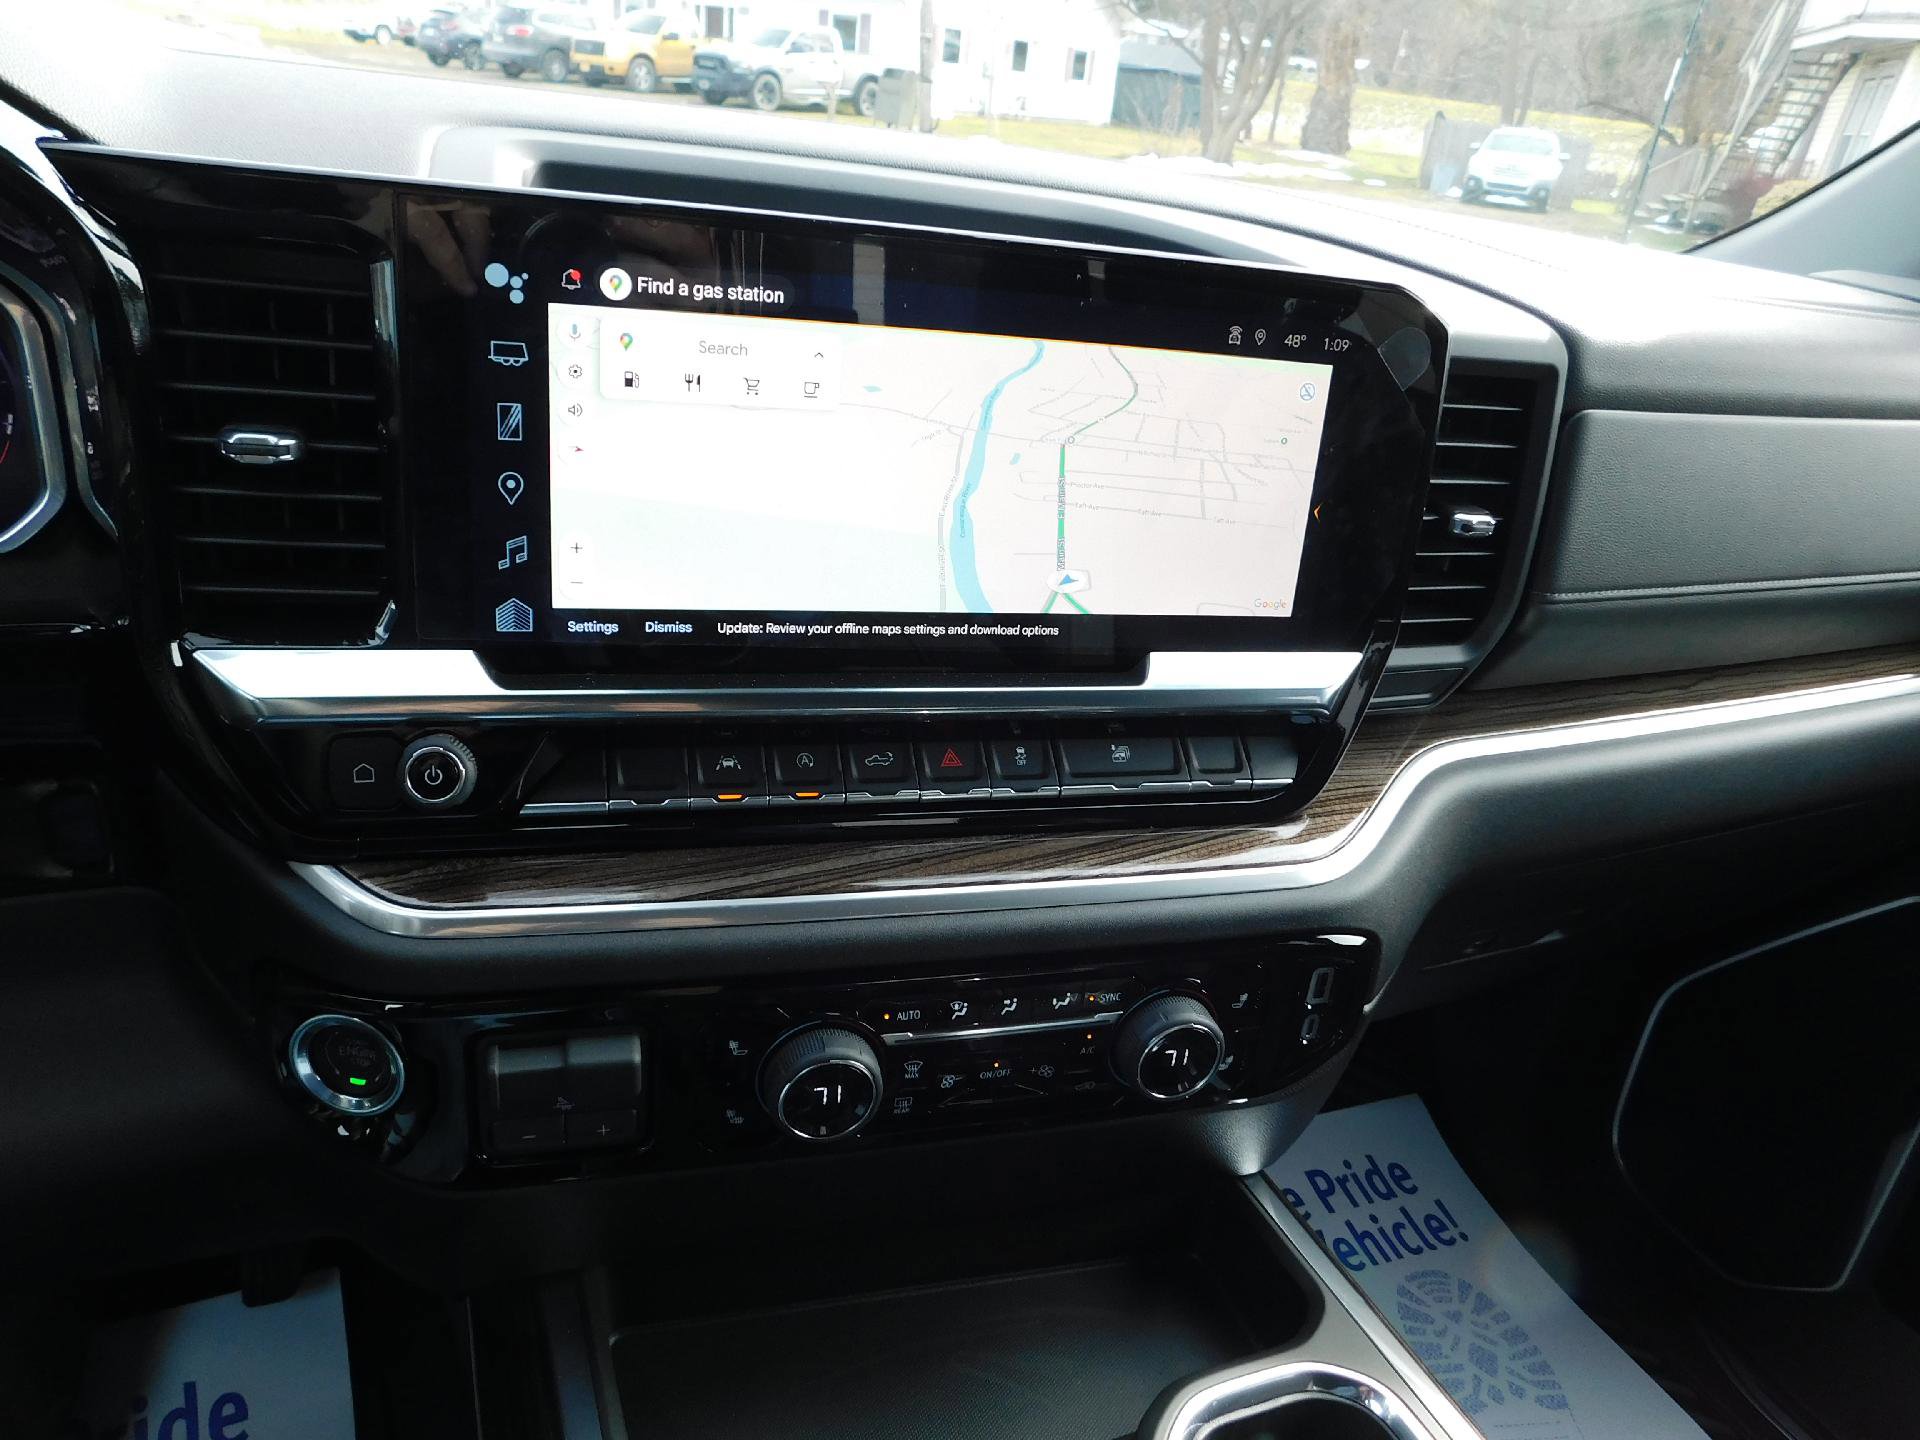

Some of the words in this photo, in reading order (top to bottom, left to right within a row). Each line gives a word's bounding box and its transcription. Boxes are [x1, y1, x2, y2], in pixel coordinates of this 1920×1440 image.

[636, 276, 675, 296] Find
[678, 283, 689, 297] a
[692, 284, 724, 301] gas
[727, 286, 785, 304] station
[698, 340, 748, 356] Search
[1284, 334, 1307, 348] 48°
[1323, 337, 1350, 352] 1:09
[1254, 598, 1288, 611] Google
[567, 620, 619, 635] Settings
[645, 621, 693, 633] Dismiss
[717, 622, 764, 636] Update:
[765, 622, 805, 634] Review
[808, 625, 833, 637] your
[835, 622, 870, 634] offline
[872, 625, 902, 637] maps
[903, 623, 946, 637] settings
[948, 624, 968, 635] and
[970, 624, 1021, 635] download
[1022, 625, 1060, 637] options
[1101, 992, 1122, 1002] SYNC
[896, 1009, 921, 1021] AUTO
[1079, 1046, 1096, 1055] A/C
[1165, 1048, 1189, 1067] 71
[904, 1071, 920, 1080] MAX
[979, 1069, 1011, 1080] ON/OFF
[813, 1084, 843, 1105] 71
[1281, 1187, 1312, 1222] e
[1304, 1154, 1419, 1214] Pride
[133, 1381, 249, 1440] ide
